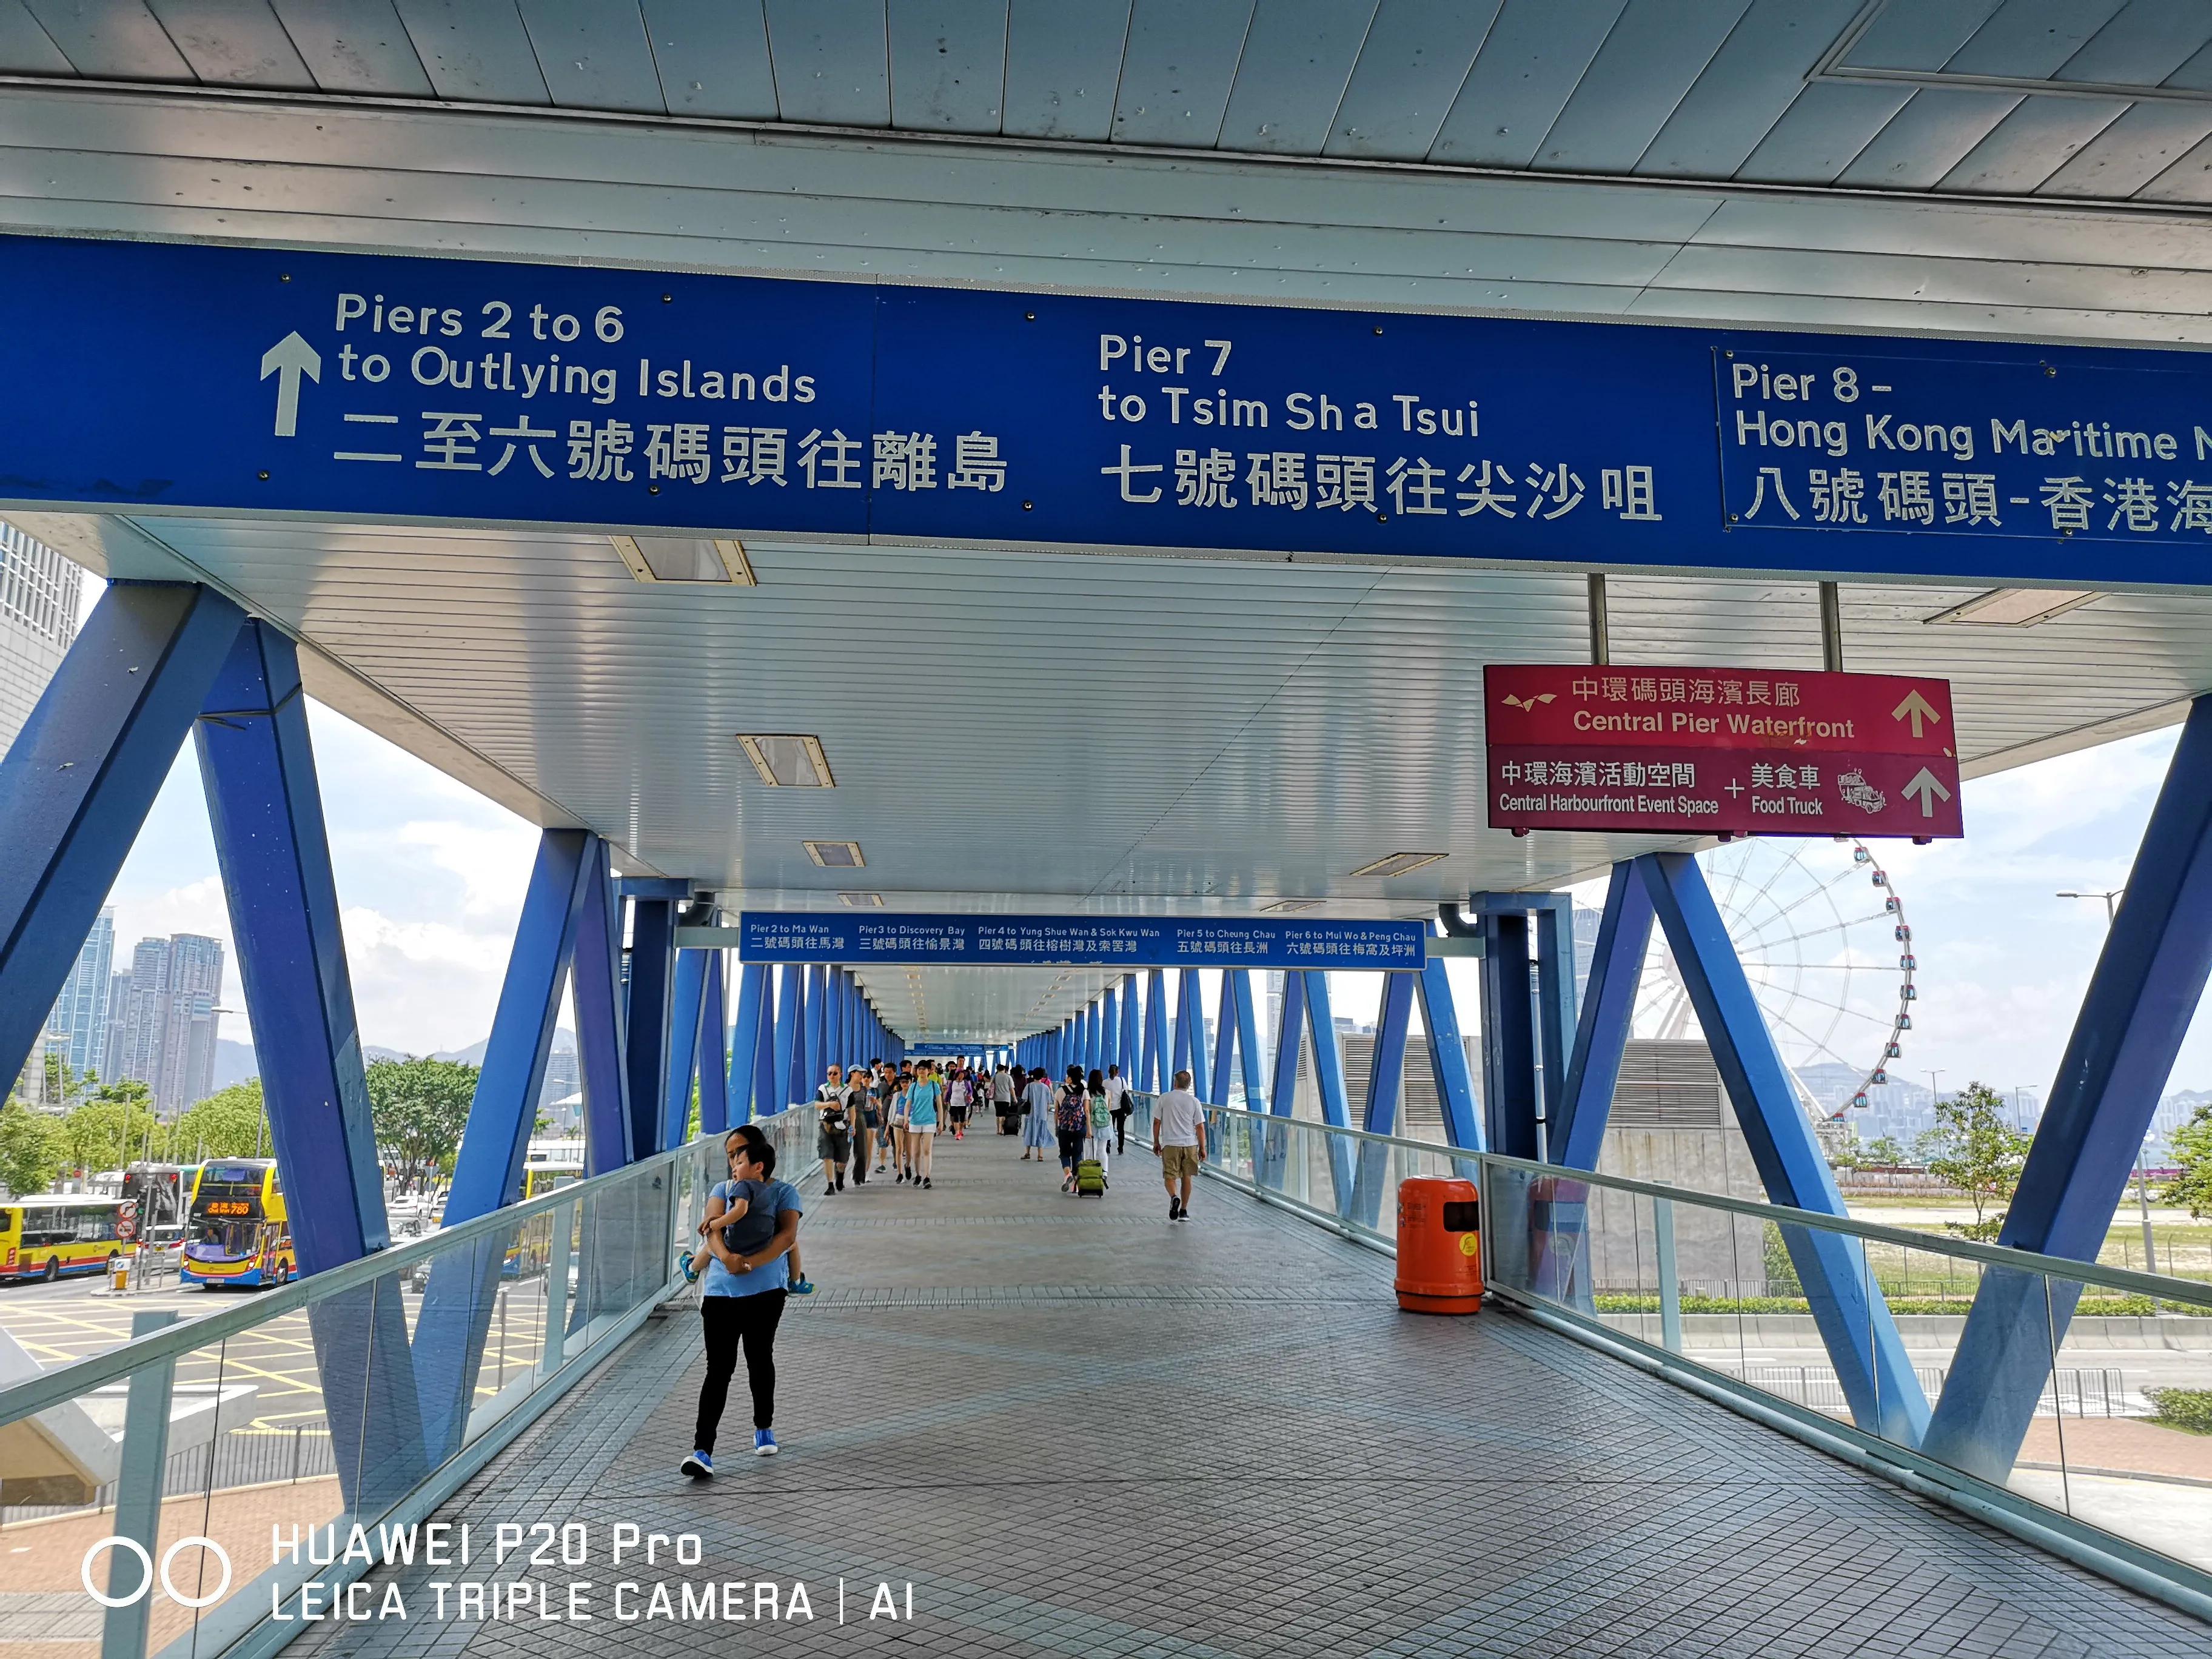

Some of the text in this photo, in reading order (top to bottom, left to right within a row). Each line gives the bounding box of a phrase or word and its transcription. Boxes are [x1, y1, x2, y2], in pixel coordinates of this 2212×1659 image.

[336, 293, 623, 343] Piers 2 to 6
[1101, 335, 1231, 375] Pier 7
[338, 344, 815, 404] to Outlying Islands
[1733, 364, 1815, 400] Pier
[1099, 385, 1145, 421] to
[1162, 387, 1267, 427] Tsim
[1393, 395, 1478, 436] Tsui
[1737, 411, 1848, 456] Hong
[1866, 414, 1974, 460] Kong
[1991, 419, 2177, 460] Maritime
[334, 412, 1007, 492] 二至六號碼頭往離島
[1101, 444, 1662, 520] 七號碼頭往尖沙咀
[1573, 676, 1800, 707] 中環碼頭海濱長廊
[1574, 711, 1854, 737] Central Pier Waterfront
[1503, 761, 1694, 788] 中環海濱活動空間
[1752, 763, 1820, 789] 美食車
[1500, 794, 1718, 817] Central Harbourfront Event Space
[1752, 796, 1823, 814] Food Truck
[900, 926, 943, 935] Discovery
[948, 927, 965, 936] Bay
[1021, 927, 1042, 937] Yung
[1218, 930, 1249, 939] Cheung
[1369, 932, 1390, 942] Peng
[1393, 933, 1415, 941] Chau
[231, 1205, 249, 1215] 780
